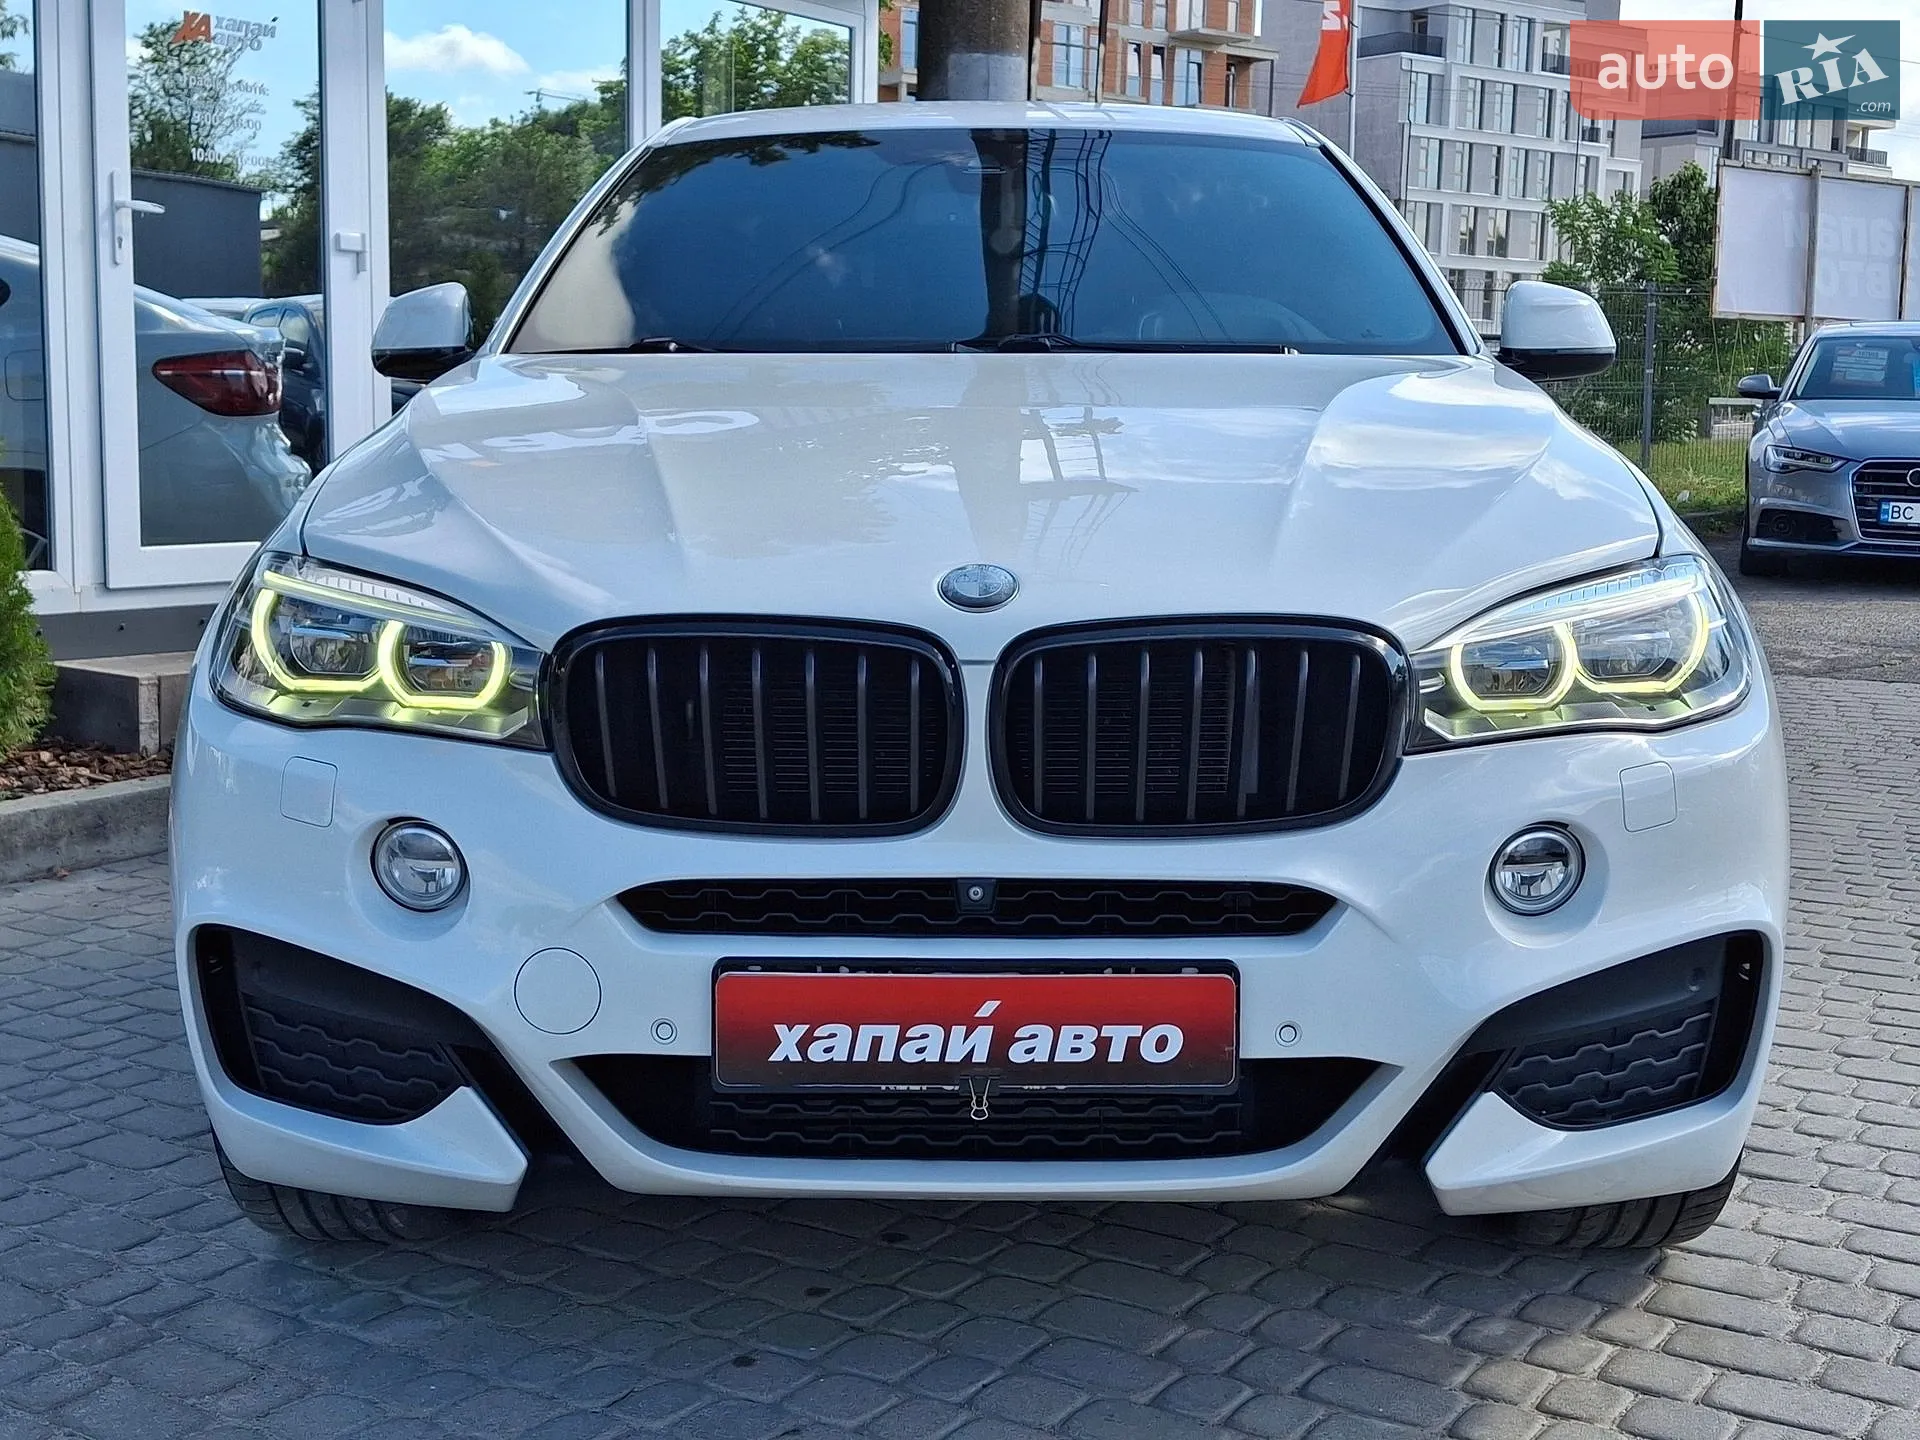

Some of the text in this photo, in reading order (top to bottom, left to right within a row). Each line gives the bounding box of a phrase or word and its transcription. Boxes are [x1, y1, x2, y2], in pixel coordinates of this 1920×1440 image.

[214, 16, 279, 39] хапай
[190, 147, 223, 164] 10:00
[1891, 505, 1914, 520] BC
[768, 1000, 1184, 1064] хапай авто
